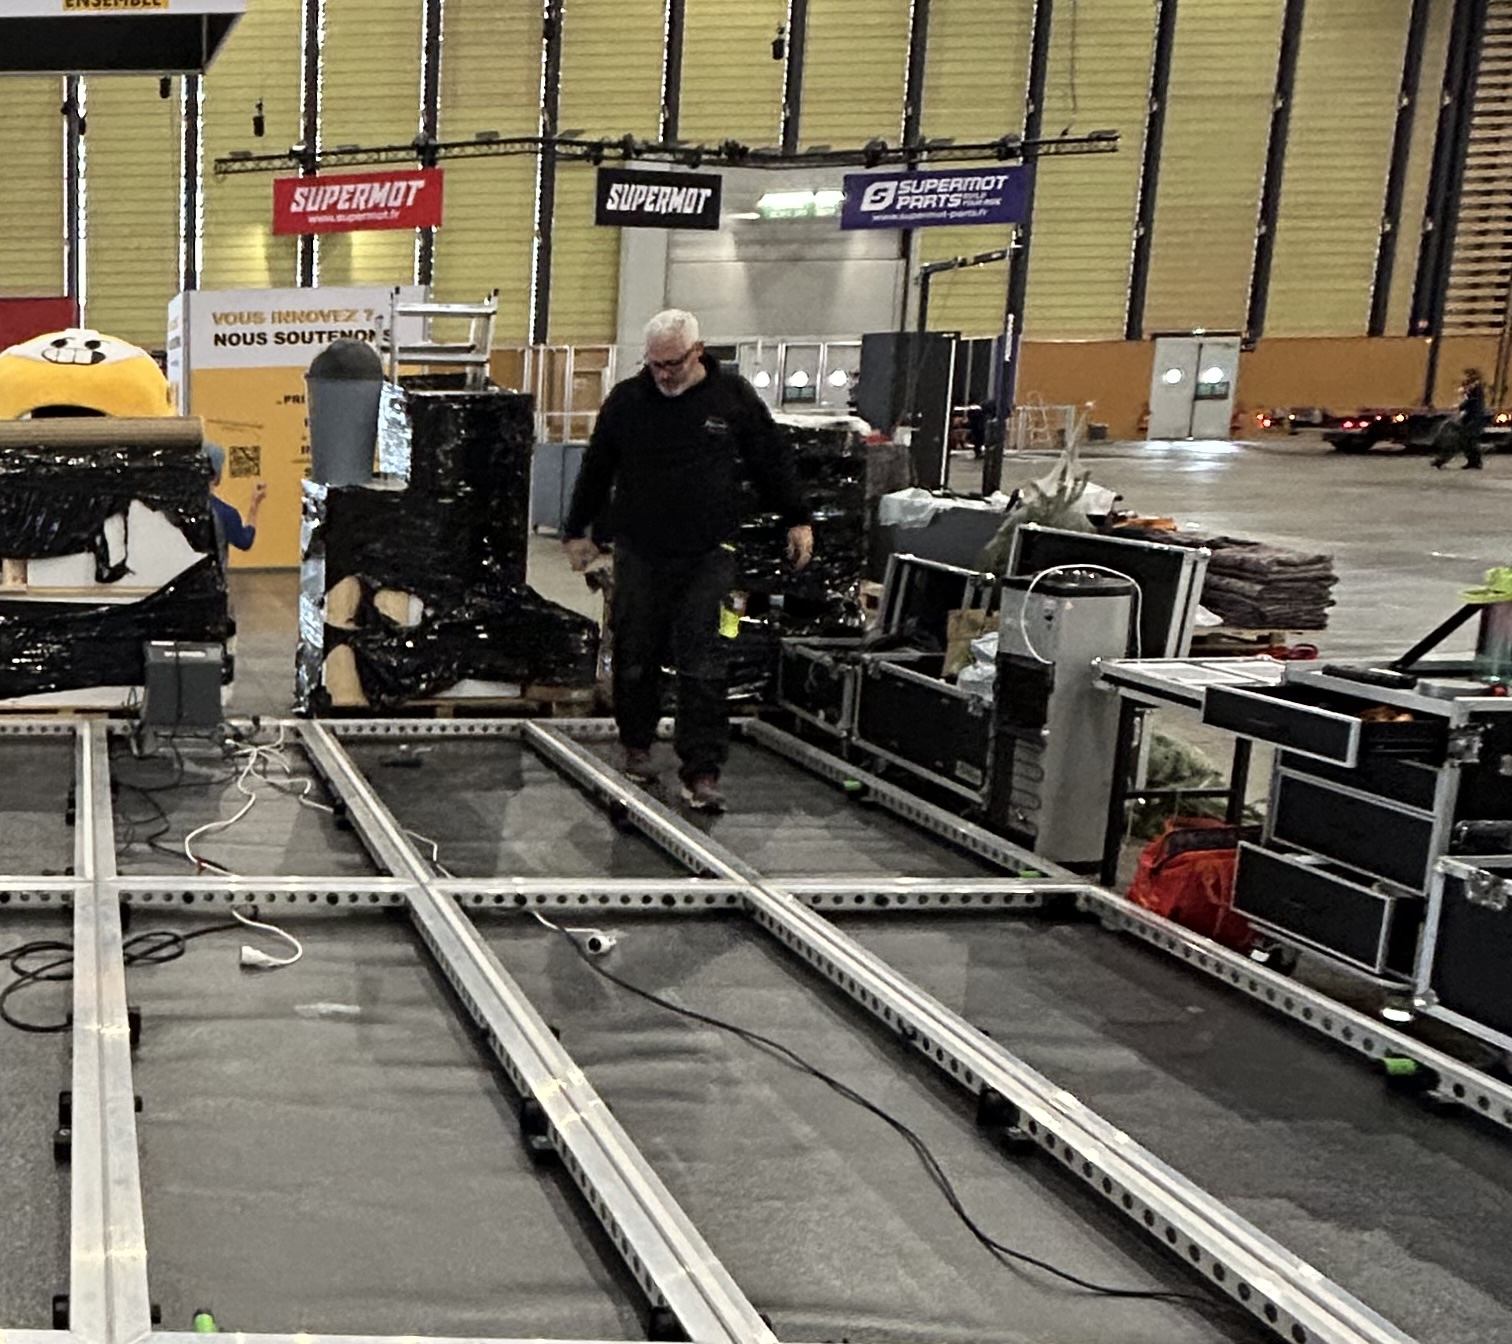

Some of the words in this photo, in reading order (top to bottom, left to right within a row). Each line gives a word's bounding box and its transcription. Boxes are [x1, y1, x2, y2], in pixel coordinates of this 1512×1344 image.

[898, 175, 1009, 194] SUPERMOT
[290, 179, 426, 214] SUPERMOT
[606, 183, 713, 215] SUPERMOT
[895, 193, 963, 210] PARTS
[212, 310, 265, 325] VOUS
[271, 309, 359, 324] INNOVEZ
[213, 332, 268, 347] NOUS
